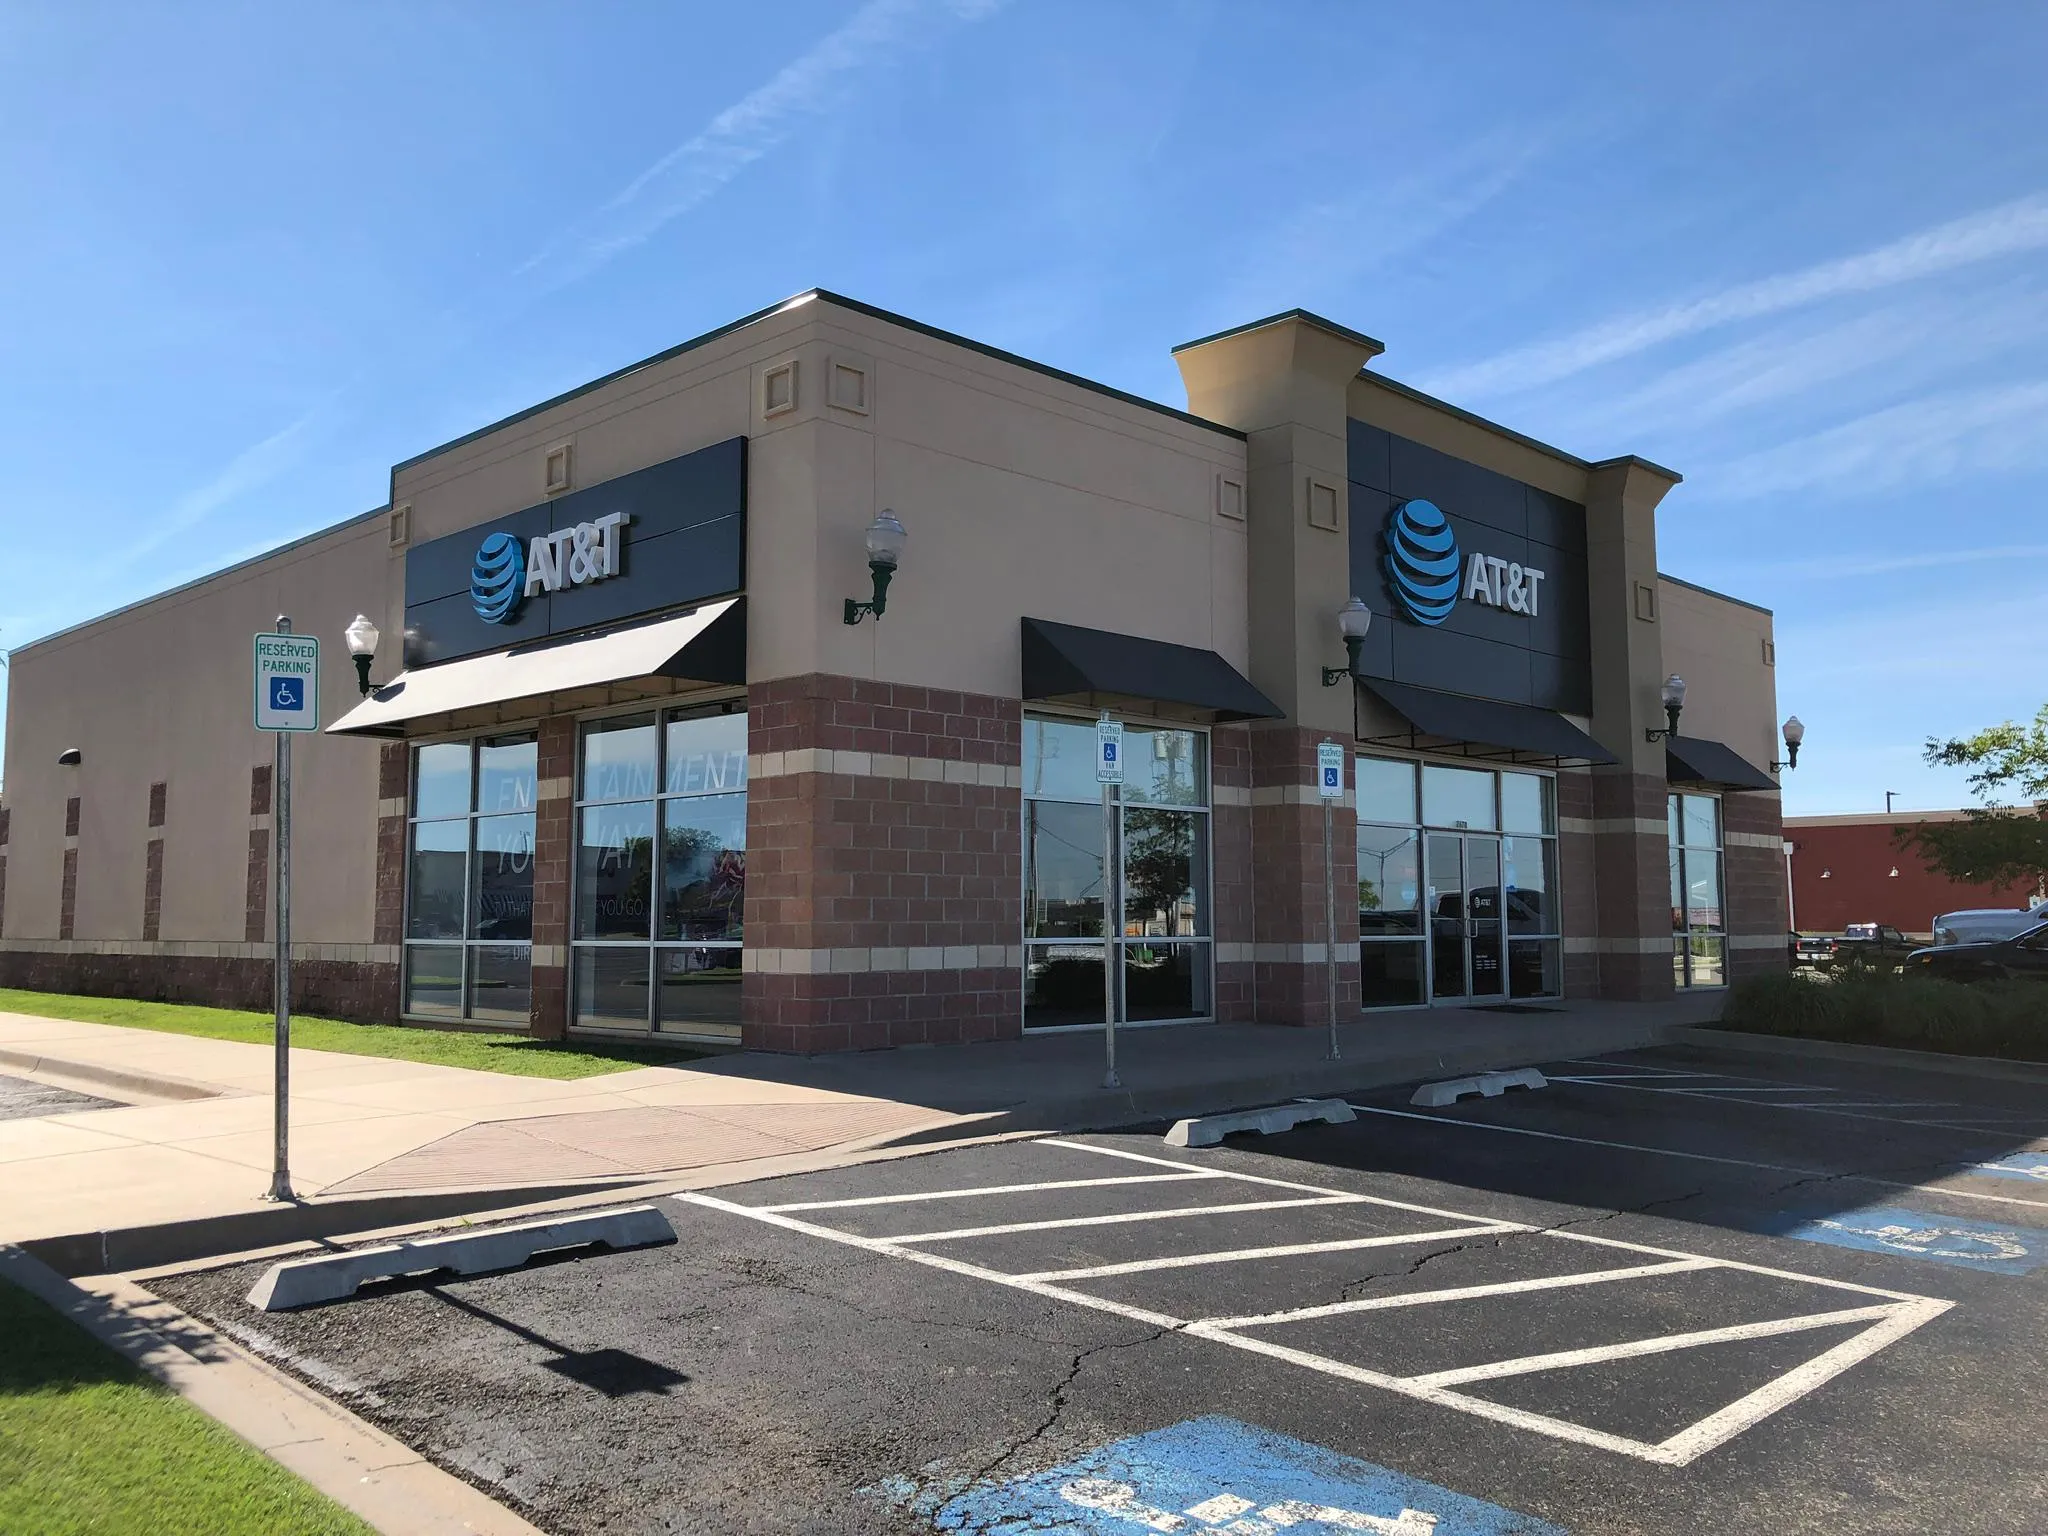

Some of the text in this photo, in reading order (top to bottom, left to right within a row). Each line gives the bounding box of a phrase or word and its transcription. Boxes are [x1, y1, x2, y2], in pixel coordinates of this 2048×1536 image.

[524, 512, 630, 597] AT&T
[1463, 553, 1545, 617] AT&T
[258, 643, 315, 658] RESERVED
[262, 660, 311, 673] PARKING
[497, 830, 536, 874] YO
[601, 899, 624, 916] YOU
